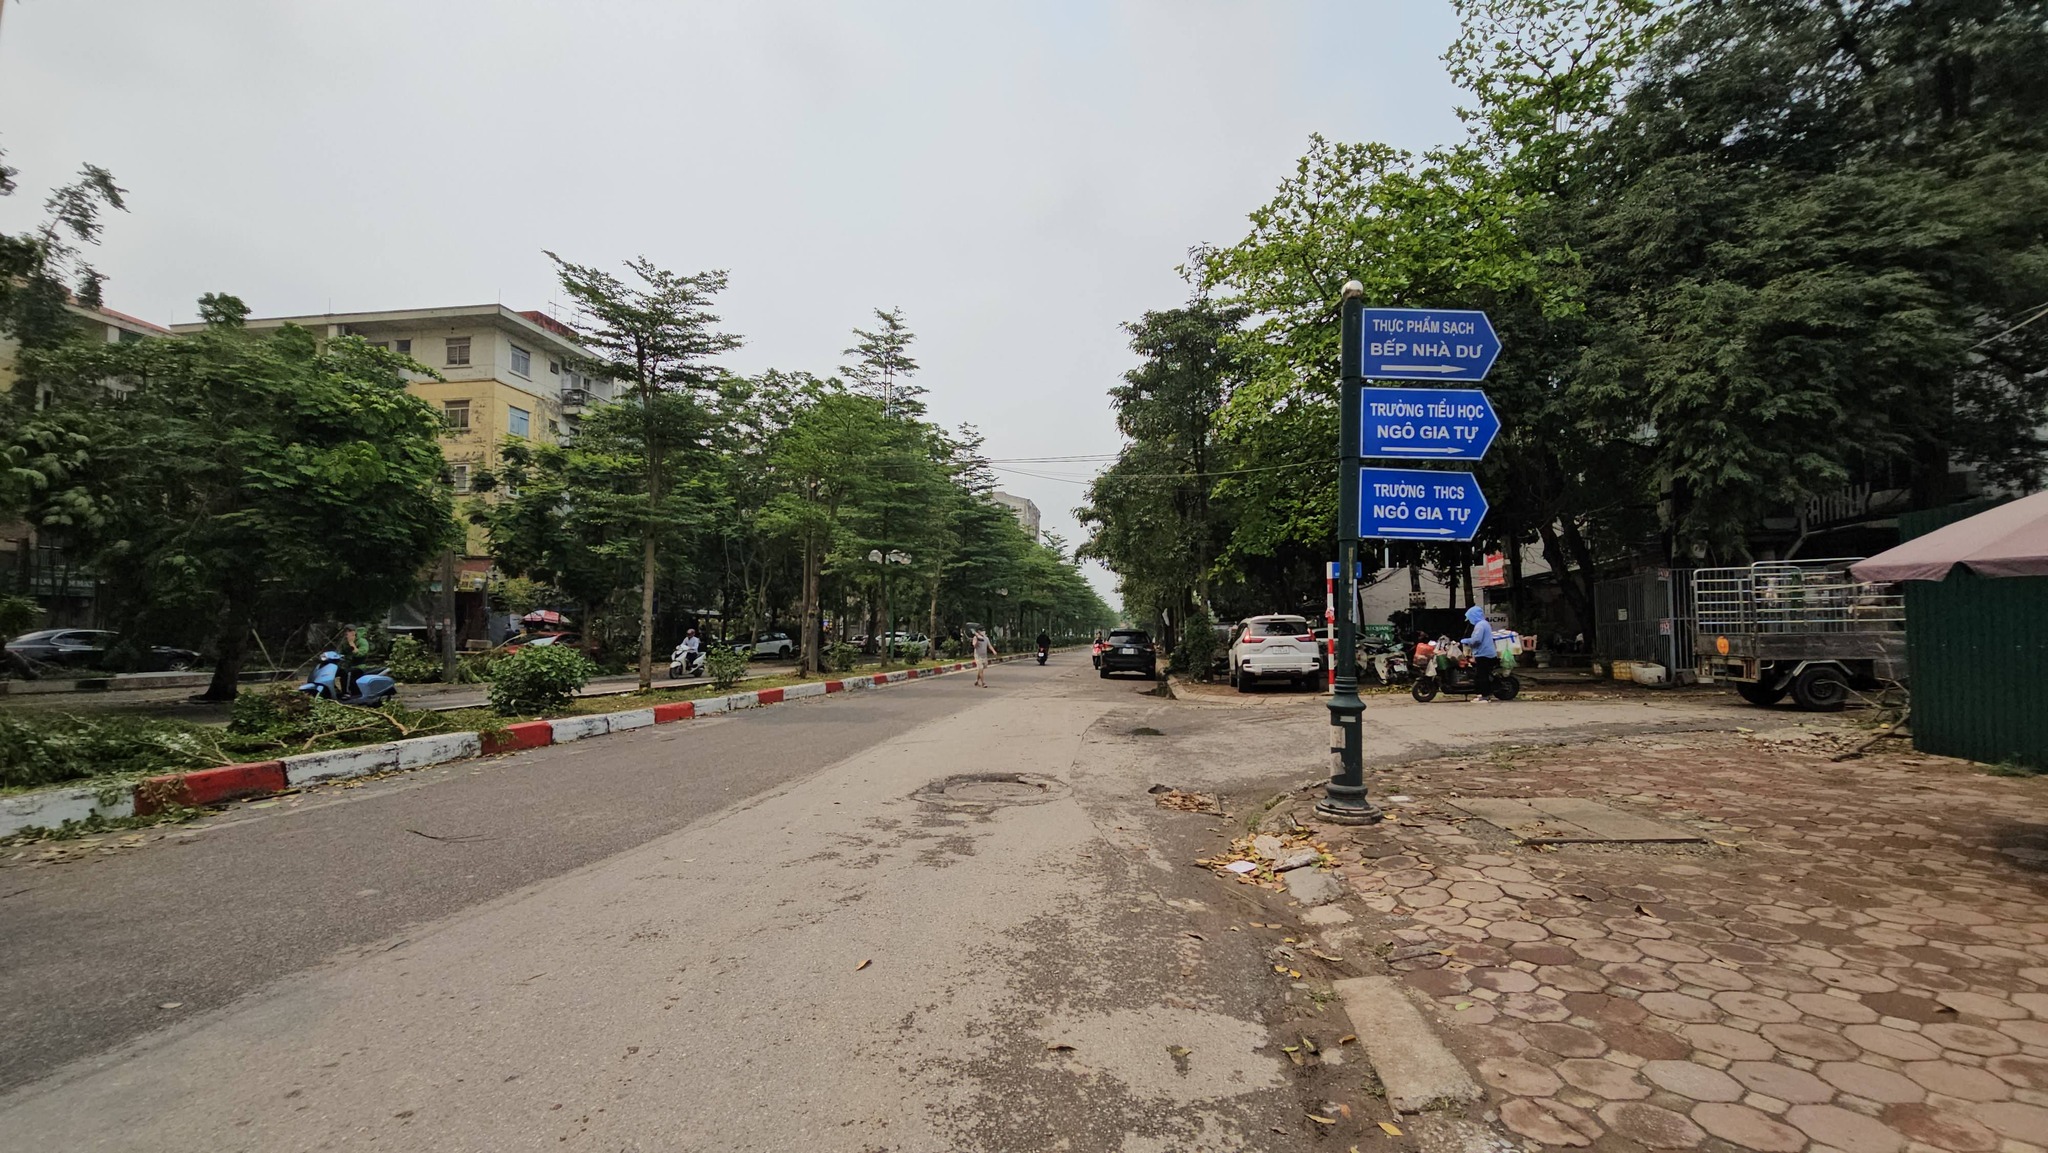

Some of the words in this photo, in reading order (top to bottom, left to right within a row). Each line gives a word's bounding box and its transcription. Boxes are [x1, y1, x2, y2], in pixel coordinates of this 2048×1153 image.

[1372, 318, 1404, 335] THỰC
[1406, 316, 1440, 333] PHẨM
[1442, 321, 1474, 336] SẠCH
[1370, 338, 1407, 356] BẾP
[1412, 340, 1451, 357] NHÀ
[1456, 344, 1483, 358] DƯ
[1370, 399, 1424, 417] TRƯỜNG
[1427, 398, 1455, 418] TIỂU
[1457, 405, 1484, 421] HỌC
[1377, 421, 1415, 439] NGÔ
[1420, 425, 1450, 439] GIA
[1453, 426, 1479, 443] TỰ
[1373, 480, 1425, 498] TRƯỜNG
[1433, 485, 1465, 500] THCS
[1373, 501, 1409, 520] NGÔ
[1414, 506, 1443, 520] GIA
[1447, 507, 1471, 525] TỰ
